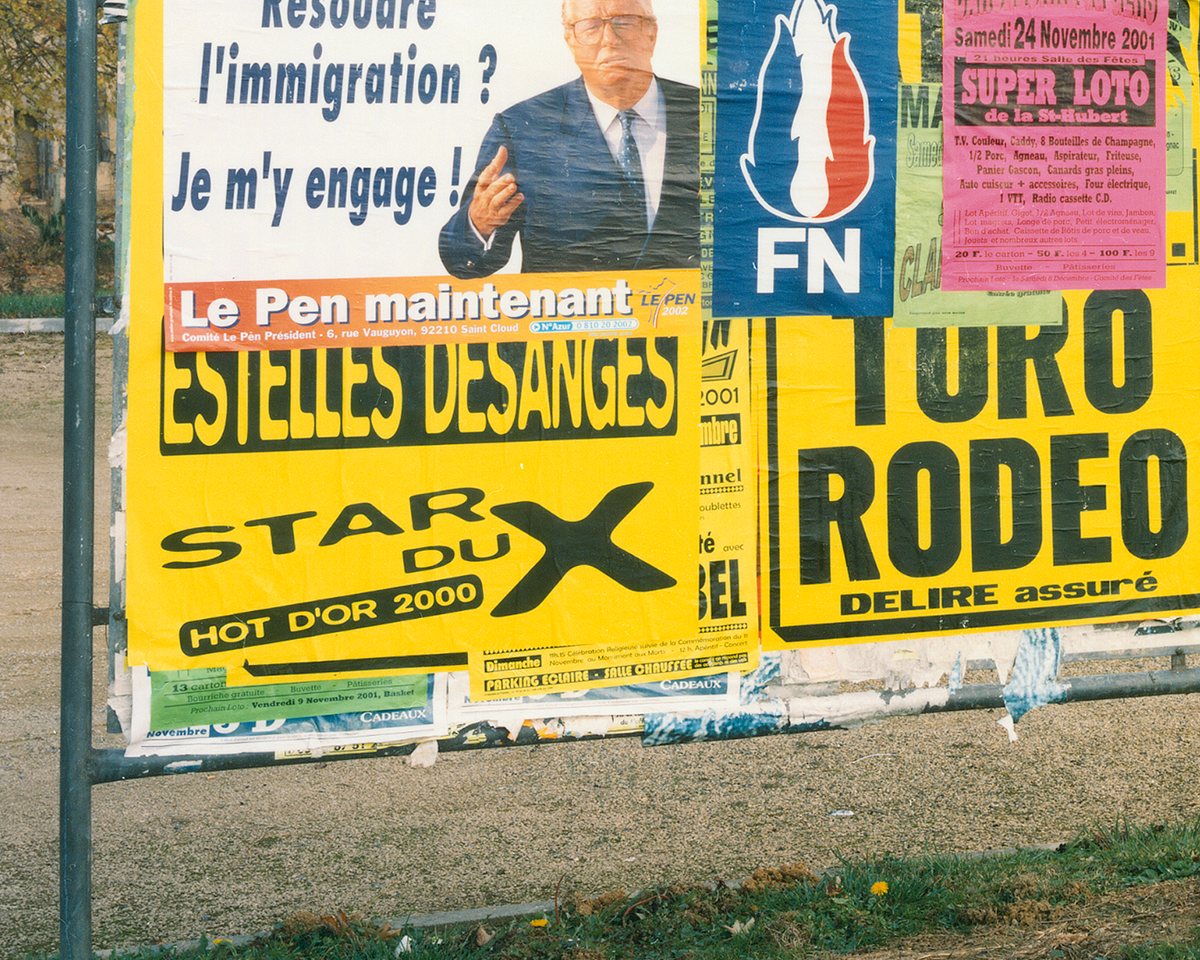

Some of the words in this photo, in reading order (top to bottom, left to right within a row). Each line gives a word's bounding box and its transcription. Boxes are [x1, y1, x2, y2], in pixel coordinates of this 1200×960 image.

[954, 21, 1012, 48] Samedi
[1014, 16, 1037, 50] 24
[1040, 19, 1116, 50] Novembre
[1122, 27, 1155, 51] 2001
[993, 54, 1038, 63] heures
[1042, 55, 1073, 63] Salle
[1077, 55, 1100, 63] des
[1104, 56, 1138, 64] Fêtes
[198, 41, 462, 123] l'immigration
[478, 43, 498, 105] ?
[961, 67, 1057, 106] SUPER
[1073, 68, 1150, 107] LOTO
[985, 109, 1009, 123] de
[1013, 109, 1034, 123] la
[1038, 109, 1129, 124] St-Hubert
[955, 135, 969, 146] T.V.
[972, 135, 1008, 148] Couleur,
[1010, 136, 1038, 149] Caddy,
[1040, 136, 1046, 146] 8
[1048, 136, 1089, 146] Bouteilles
[1092, 136, 1102, 146] de
[1104, 136, 1156, 149] Champagne,
[969, 150, 982, 162] 1/2
[985, 150, 1008, 162] Porc,
[1013, 150, 1048, 162] Agneau,
[1053, 150, 1100, 162] Aspirateur,
[1105, 151, 1142, 162] Friteuse,
[976, 164, 1005, 175] Panier
[1008, 165, 1041, 177] Gascon,
[1047, 164, 1082, 175] Canards
[1085, 166, 1104, 177] gras
[1106, 164, 1135, 177] pleins,
[170, 152, 212, 213] Je
[224, 151, 294, 228] m'y
[305, 165, 438, 227] engage
[450, 146, 463, 207] !
[960, 178, 979, 189] Auto
[981, 178, 1014, 189] cuiseur
[1028, 179, 1079, 191] accessoires,
[1084, 179, 1104, 189] Four
[1106, 179, 1151, 191] électrique,
[1007, 193, 1026, 206] VTT,
[1032, 193, 1057, 203] Radio
[1059, 193, 1093, 204] cassette
[1096, 193, 1113, 204] C.D.
[1121, 227, 1131, 235] de
[756, 227, 861, 294] FN
[955, 250, 969, 258] 20
[995, 250, 1025, 258] carton
[1036, 250, 1051, 258] 50
[1100, 249, 1119, 257] 100
[1062, 263, 1116, 271] Pâtisseries
[180, 289, 241, 329] Le
[255, 287, 350, 327] Pen
[365, 278, 633, 324] maintenant
[641, 293, 661, 307] LE
[663, 292, 696, 305] PEN
[661, 306, 689, 316] 2002
[182, 331, 220, 343] Comité
[223, 332, 237, 342] Le
[264, 329, 317, 341] Président
[326, 330, 338, 340] 6,
[341, 330, 359, 339] rue
[362, 327, 418, 340] Vauguyon,
[420, 324, 458, 335] 92210
[461, 323, 487, 335] Saint
[490, 322, 519, 333] Cloud
[163, 344, 404, 447] ESTELLES
[425, 337, 676, 436] DESANGES
[797, 428, 1190, 586] RODEO
[160, 487, 486, 570] STAR
[402, 532, 511, 574] DU
[489, 480, 678, 618] X
[723, 543, 744, 552] avec
[839, 582, 999, 616] DELIRE
[1014, 570, 1160, 603] assuré
[189, 616, 271, 649] HOT
[288, 598, 378, 633] D'OR
[393, 581, 477, 615] 2000
[485, 657, 542, 673] Dimanche
[486, 675, 540, 692] PARKING
[541, 670, 589, 686] ECLAIRE
[604, 665, 633, 680] SALLE
[634, 658, 693, 676] CHAUFFEE
[172, 683, 188, 693] 13
[187, 692, 230, 703] Bourriche
[230, 690, 265, 700] gratuite
[290, 684, 322, 693] Buvette
[347, 678, 393, 688] Pâtisseries
[659, 679, 722, 691] CADEAUX
[190, 704, 227, 715] Prochain
[226, 703, 245, 712] Loto
[252, 697, 296, 709] Vendredi
[298, 698, 304, 706] 9
[306, 694, 354, 705] Novembre
[357, 691, 381, 701] 2001,
[384, 688, 415, 698] Basket
[359, 709, 427, 724] CADEAUX
[146, 727, 207, 738] Novembre
